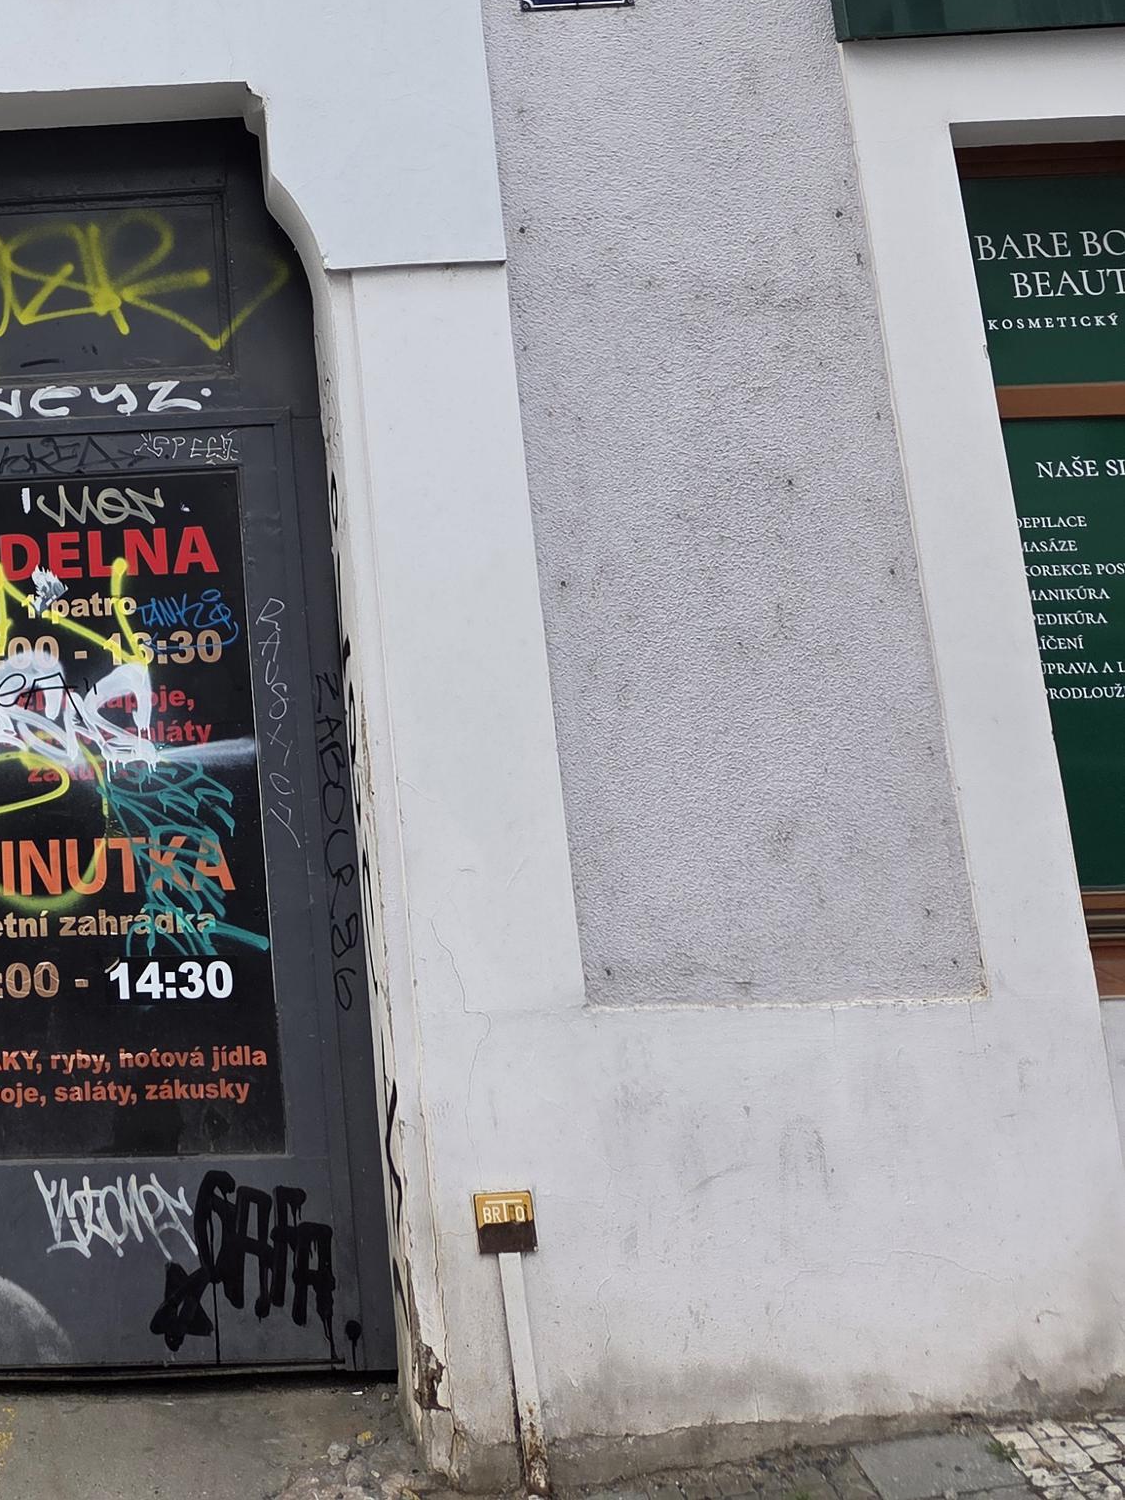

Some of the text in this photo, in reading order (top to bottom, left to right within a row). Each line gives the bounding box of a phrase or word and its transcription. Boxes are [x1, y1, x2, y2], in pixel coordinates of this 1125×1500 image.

[974, 231, 1072, 261] BARE
[987, 312, 1119, 331] KOSMETICKÝ
[1035, 456, 1099, 478] NAŠE
[1095, 562, 1125, 576] POS
[1037, 634, 1084, 650] ÍČENÍ
[1102, 661, 1114, 674] A
[58, 908, 218, 938] zahrádka
[108, 960, 234, 1001] 14:30
[50, 1049, 111, 1075] ryby,
[119, 1045, 205, 1068] hotová
[211, 1044, 268, 1070] jídla
[54, 1080, 138, 1106] saláty,
[145, 1077, 250, 1104] zákusky
